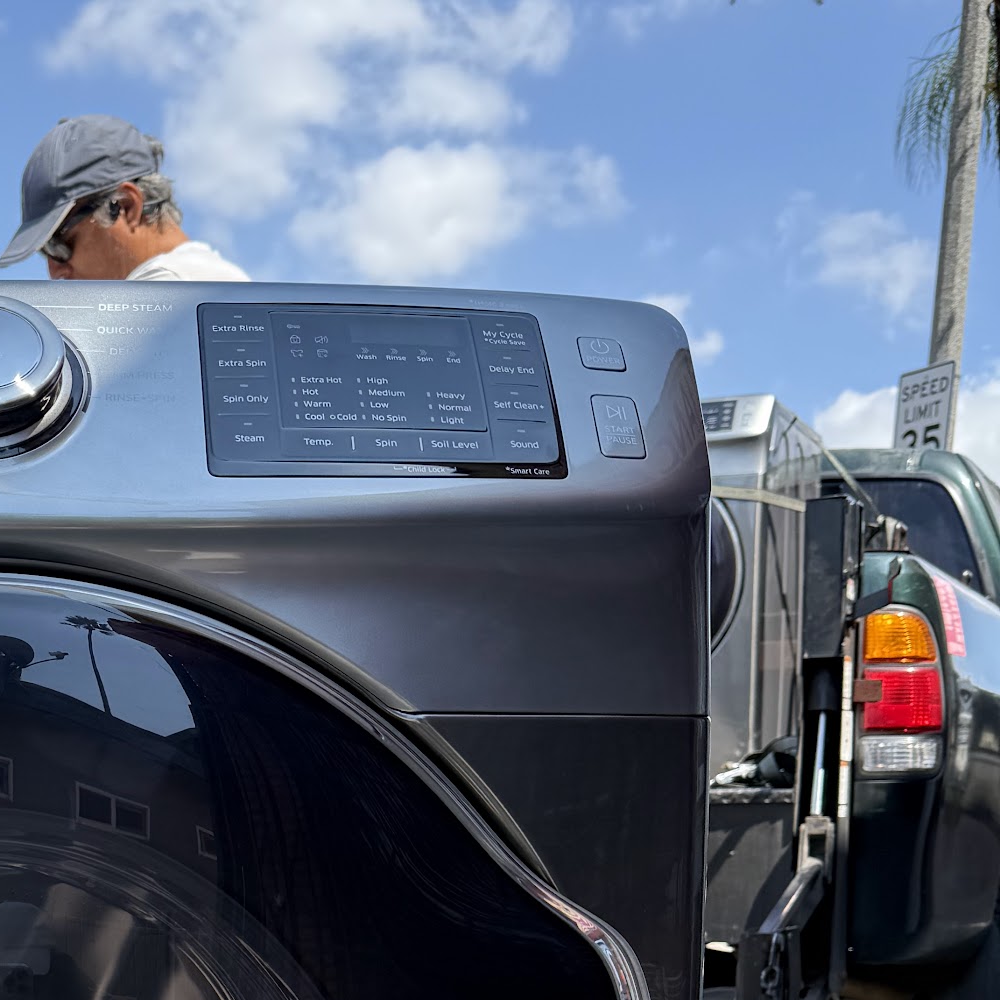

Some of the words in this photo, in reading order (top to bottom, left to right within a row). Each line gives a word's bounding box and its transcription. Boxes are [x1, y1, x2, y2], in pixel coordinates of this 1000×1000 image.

[99, 303, 129, 311] DEEP
[97, 326, 133, 334] QUICK
[483, 330, 497, 338] My
[499, 331, 524, 339] Cycle
[245, 360, 267, 368] Spin
[586, 356, 621, 365] POWER
[489, 365, 515, 374] Delay
[366, 377, 389, 385] High
[368, 389, 406, 397] Medium
[902, 376, 949, 402] SPEED
[223, 395, 244, 404] Spin
[246, 395, 269, 404] Only
[436, 392, 466, 401] Heavy
[370, 401, 389, 409] Low
[438, 403, 472, 412] Normal
[493, 400, 512, 409] Self
[904, 400, 942, 424] LIMIT
[304, 413, 325, 421] Cool
[337, 413, 358, 421] Cold
[386, 414, 407, 422] Spin
[440, 416, 465, 425] Light
[604, 425, 635, 434] START
[235, 434, 265, 442] Steam
[303, 437, 334, 446] Temp.
[606, 435, 637, 445] PAUSE
[375, 439, 398, 447] Spin
[431, 440, 449, 448] Soil
[452, 441, 479, 449] Level
[510, 440, 540, 449] Sound
[533, 467, 550, 475] Care
